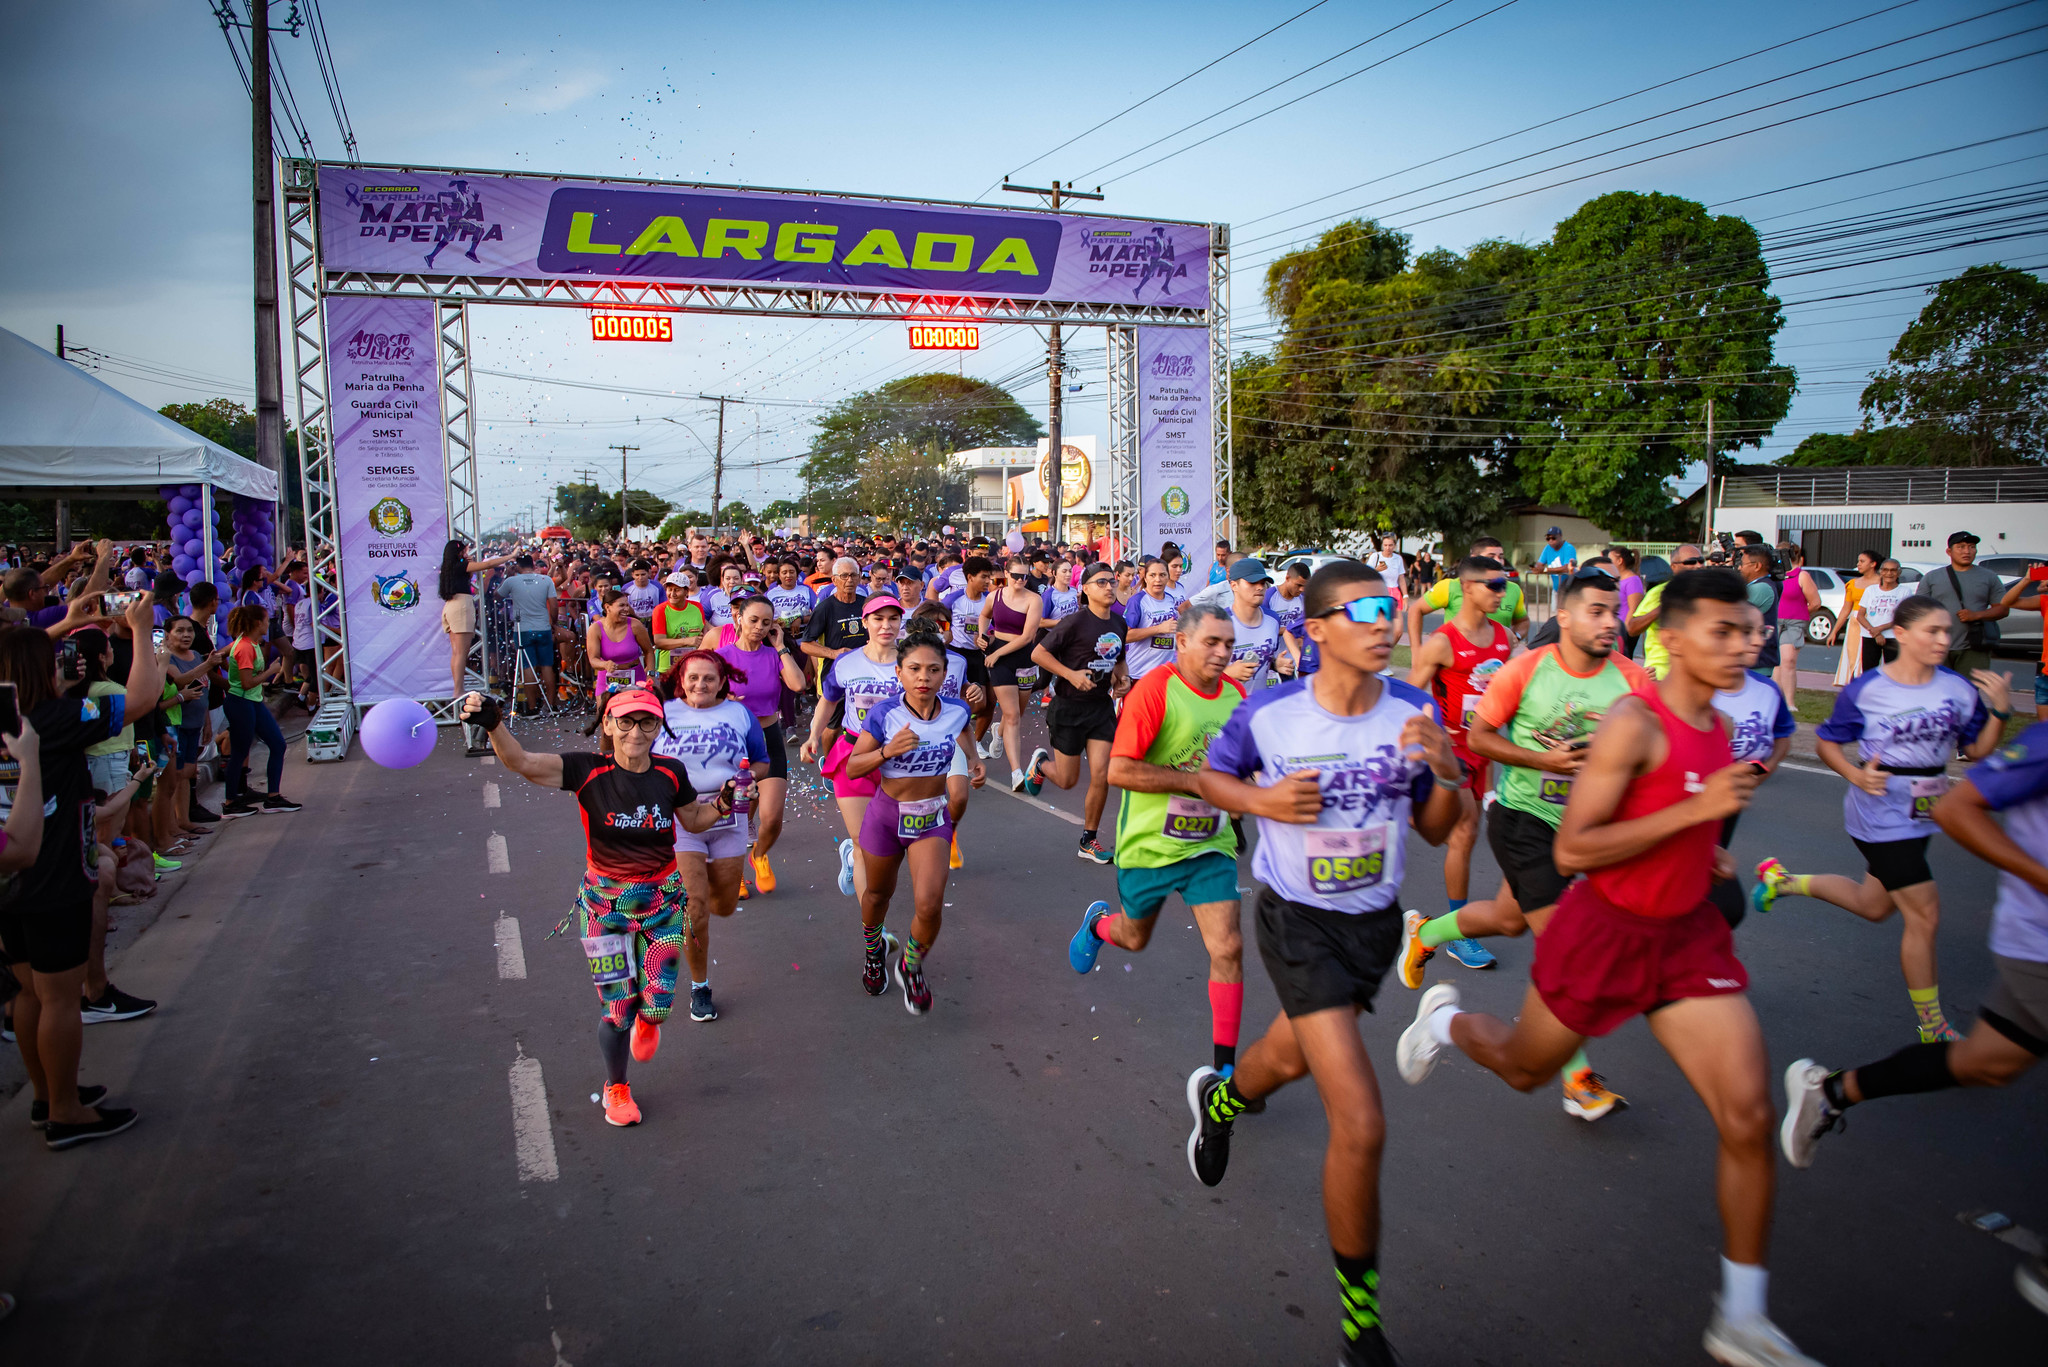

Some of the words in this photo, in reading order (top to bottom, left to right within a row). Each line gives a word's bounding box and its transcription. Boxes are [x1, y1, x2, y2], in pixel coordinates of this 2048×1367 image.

[359, 193, 436, 202] PATRULHA
[360, 226, 387, 237] DA
[388, 223, 504, 243] PENHA
[567, 211, 1040, 276] LARGADA
[1089, 264, 1108, 273] DA
[1108, 263, 1187, 278] PENHA
[912, 327, 978, 347] 00:00:00
[361, 373, 405, 382] Patrulha
[345, 383, 374, 391] Maria
[376, 383, 390, 391] da
[393, 383, 425, 392] Penha
[351, 400, 391, 409] Guarda
[394, 400, 418, 409] Civil
[360, 410, 413, 420] Municipal
[1152, 408, 1179, 416] Guarda
[1180, 408, 1197, 416] Civil
[1158, 416, 1193, 425] Municipal
[372, 429, 404, 438] SMST
[1165, 431, 1186, 439] SMST
[367, 465, 415, 475] SEMGES
[1908, 523, 1926, 531] 1476
[368, 550, 389, 558] BOA
[391, 549, 418, 558] VISTA
[1154, 637, 1172, 646] 0921
[893, 763, 908, 771] DA
[1173, 816, 1214, 832] 0271
[1311, 852, 1383, 882] 0506
